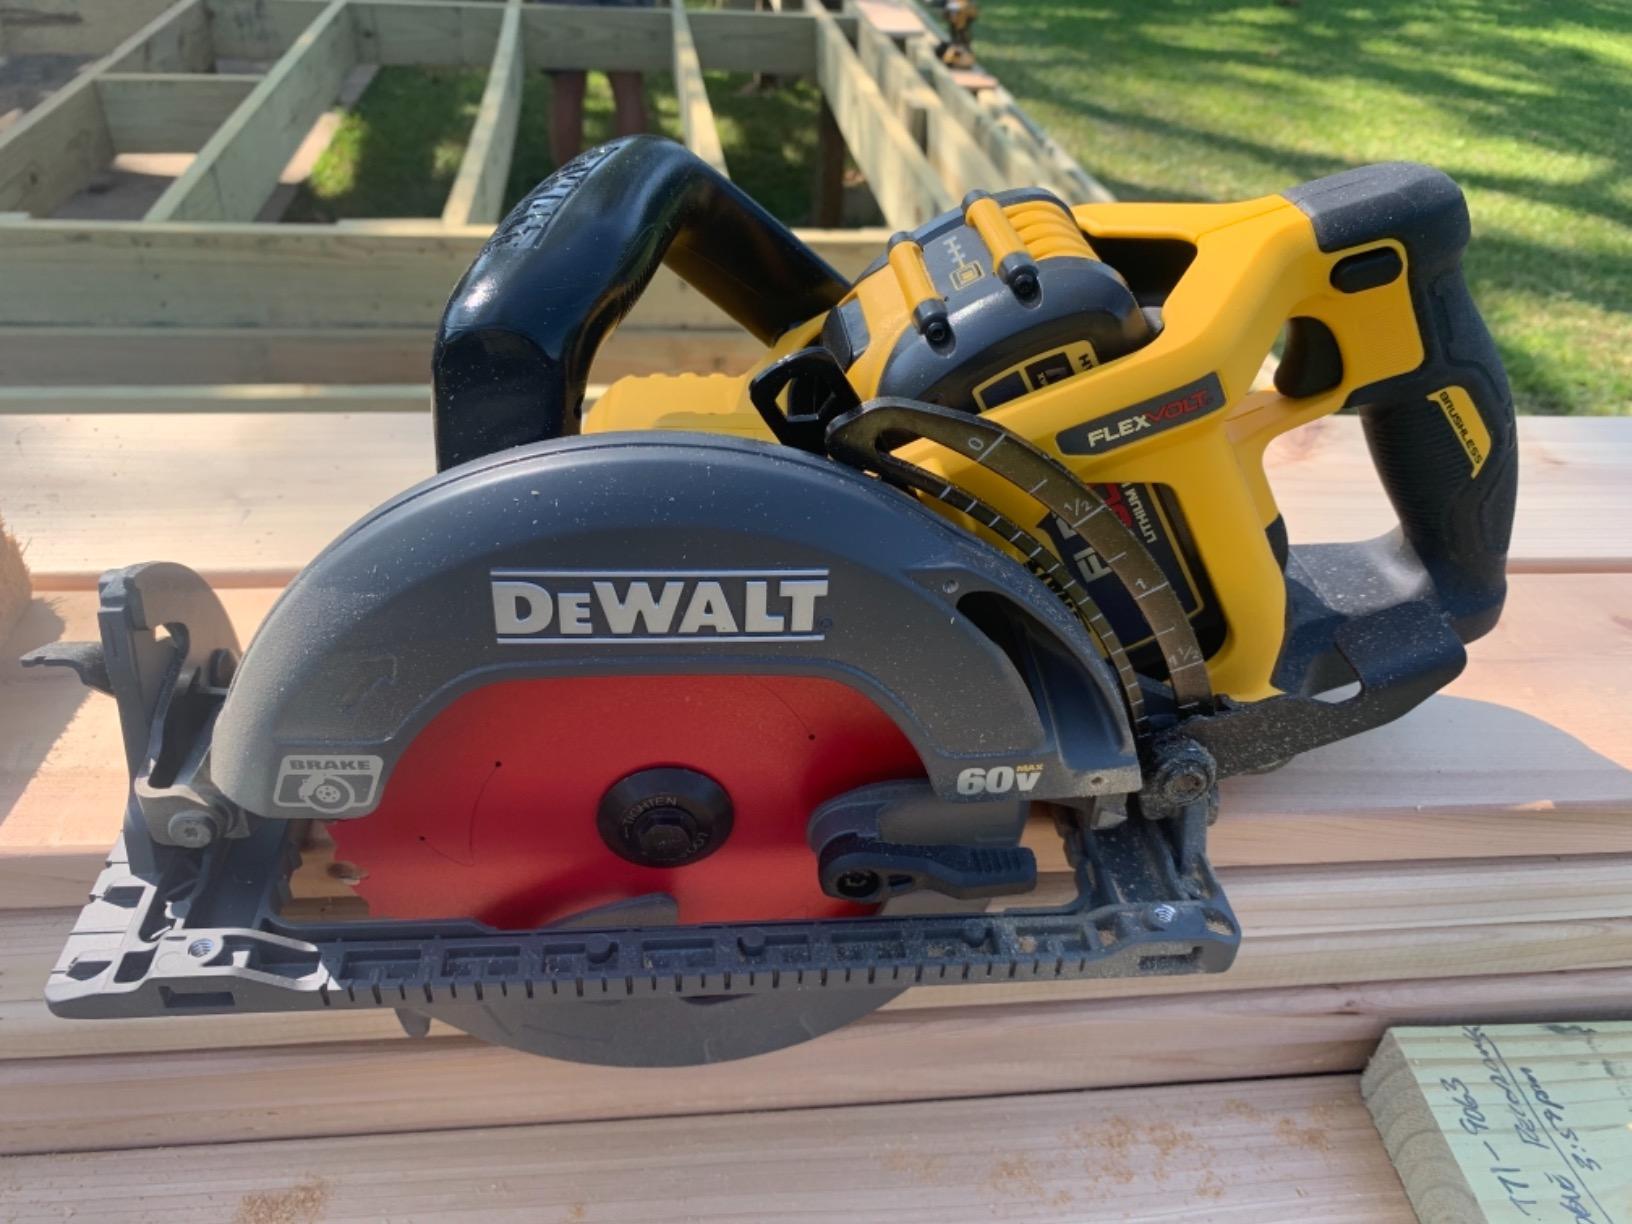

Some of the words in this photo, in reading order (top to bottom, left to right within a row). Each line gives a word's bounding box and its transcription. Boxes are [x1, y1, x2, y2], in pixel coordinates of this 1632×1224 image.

[1087, 390, 1208, 448] FLEXVOLT
[1440, 391, 1483, 464] BRUSHLESS
[1123, 486, 1158, 543] LITHIUM
[491, 579, 829, 635] DEWALT
[289, 759, 372, 772] BRAKE
[1016, 762, 1044, 773] MAX
[622, 795, 677, 827] TIGHTEN
